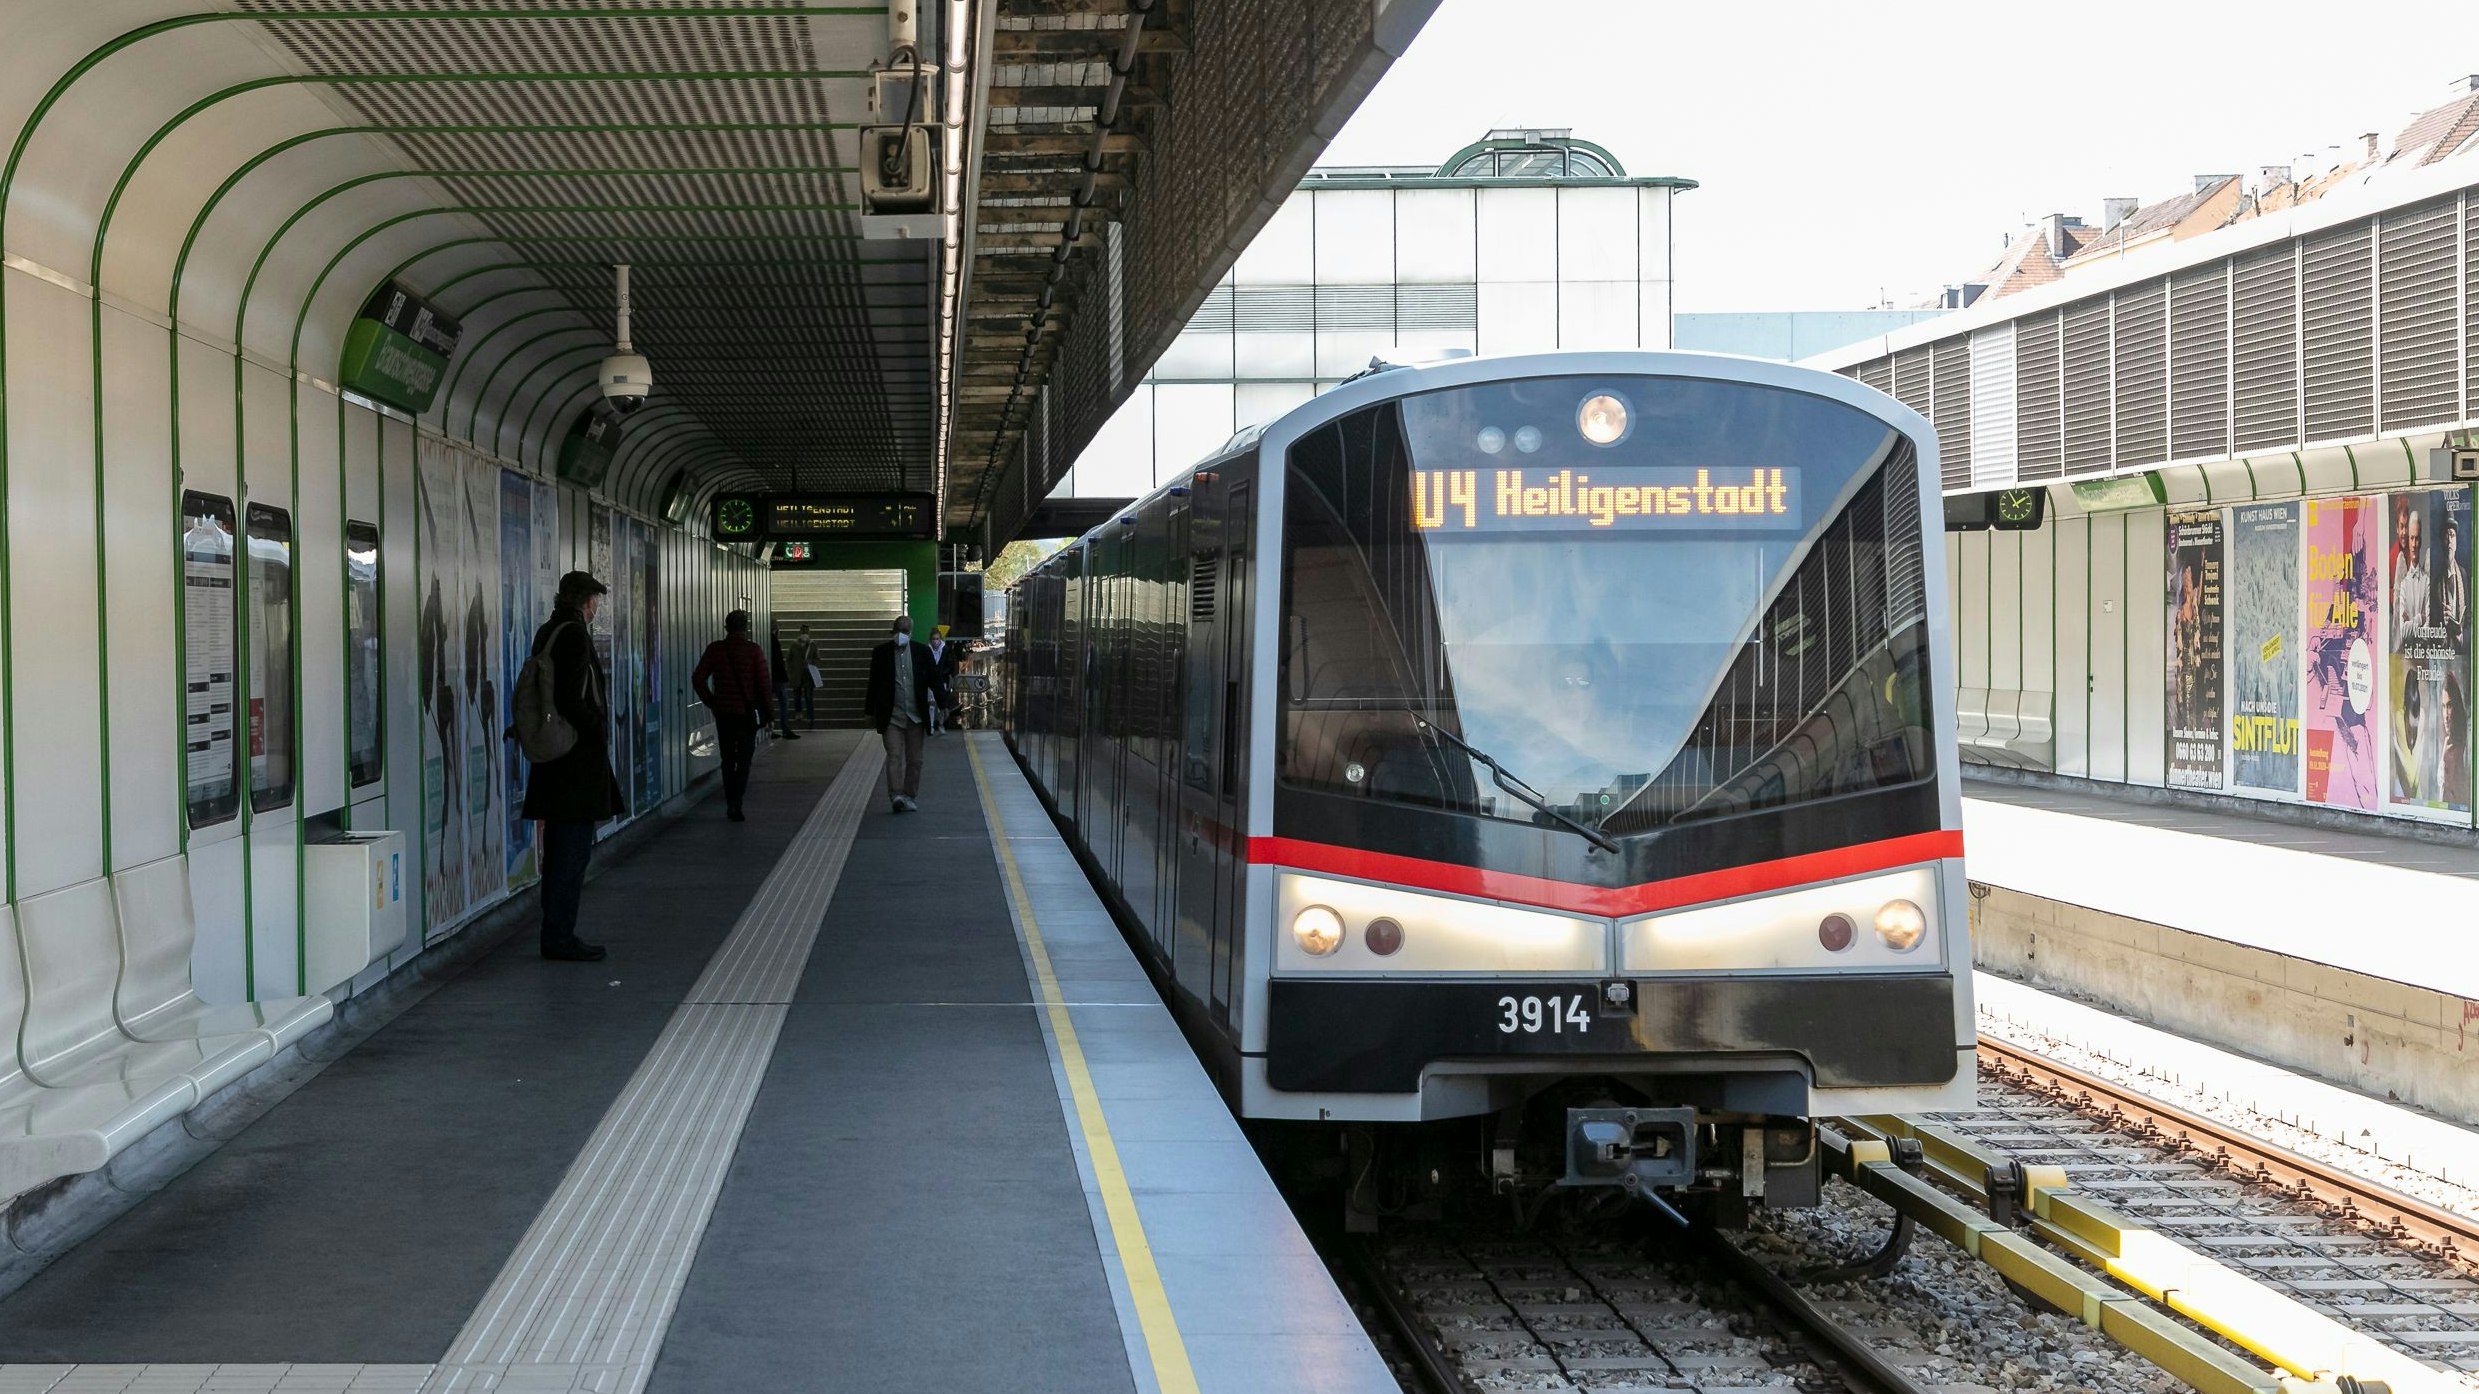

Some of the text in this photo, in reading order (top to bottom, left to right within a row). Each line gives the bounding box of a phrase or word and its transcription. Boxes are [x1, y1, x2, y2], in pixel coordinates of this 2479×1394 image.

[1415, 469, 1787, 527] U4 Heiligenstadt
[2308, 544, 2354, 581] Boden
[2331, 590, 2359, 629] Alle
[2404, 643, 2456, 660] ist die schönste
[2232, 714, 2299, 756] SINTFLUT
[1498, 994, 1591, 1033] 3914
